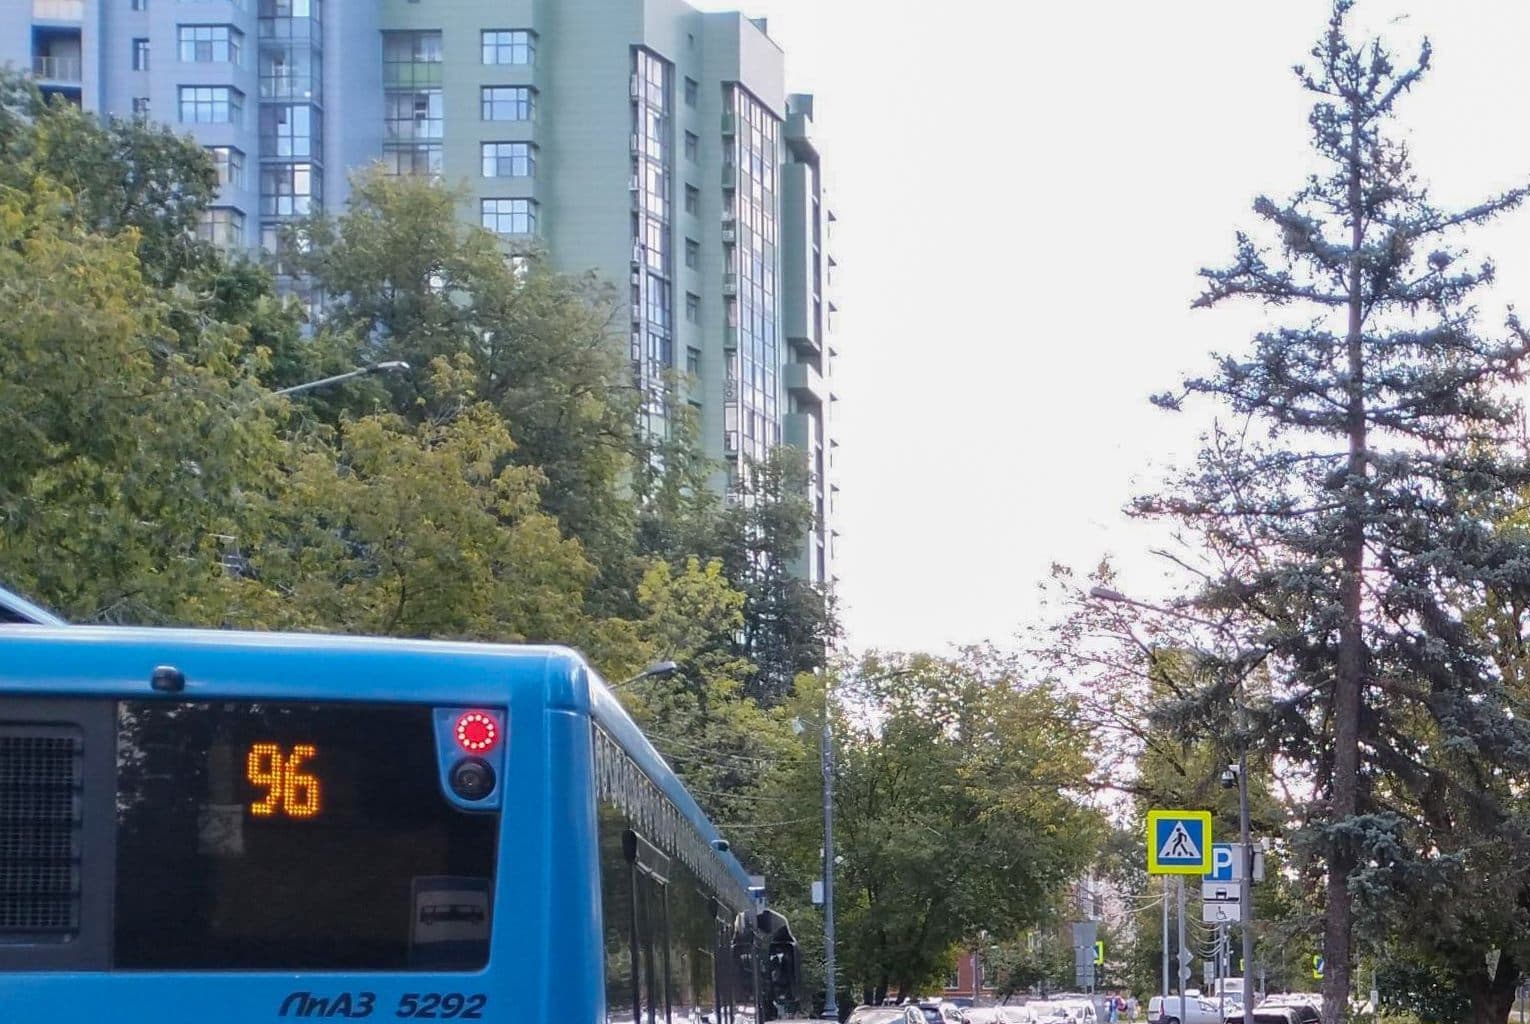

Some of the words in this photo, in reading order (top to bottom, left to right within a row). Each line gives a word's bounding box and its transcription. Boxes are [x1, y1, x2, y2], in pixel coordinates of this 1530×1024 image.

[247, 743, 320, 817] 96
[1212, 847, 1233, 879] P
[396, 992, 488, 1019] 5292
